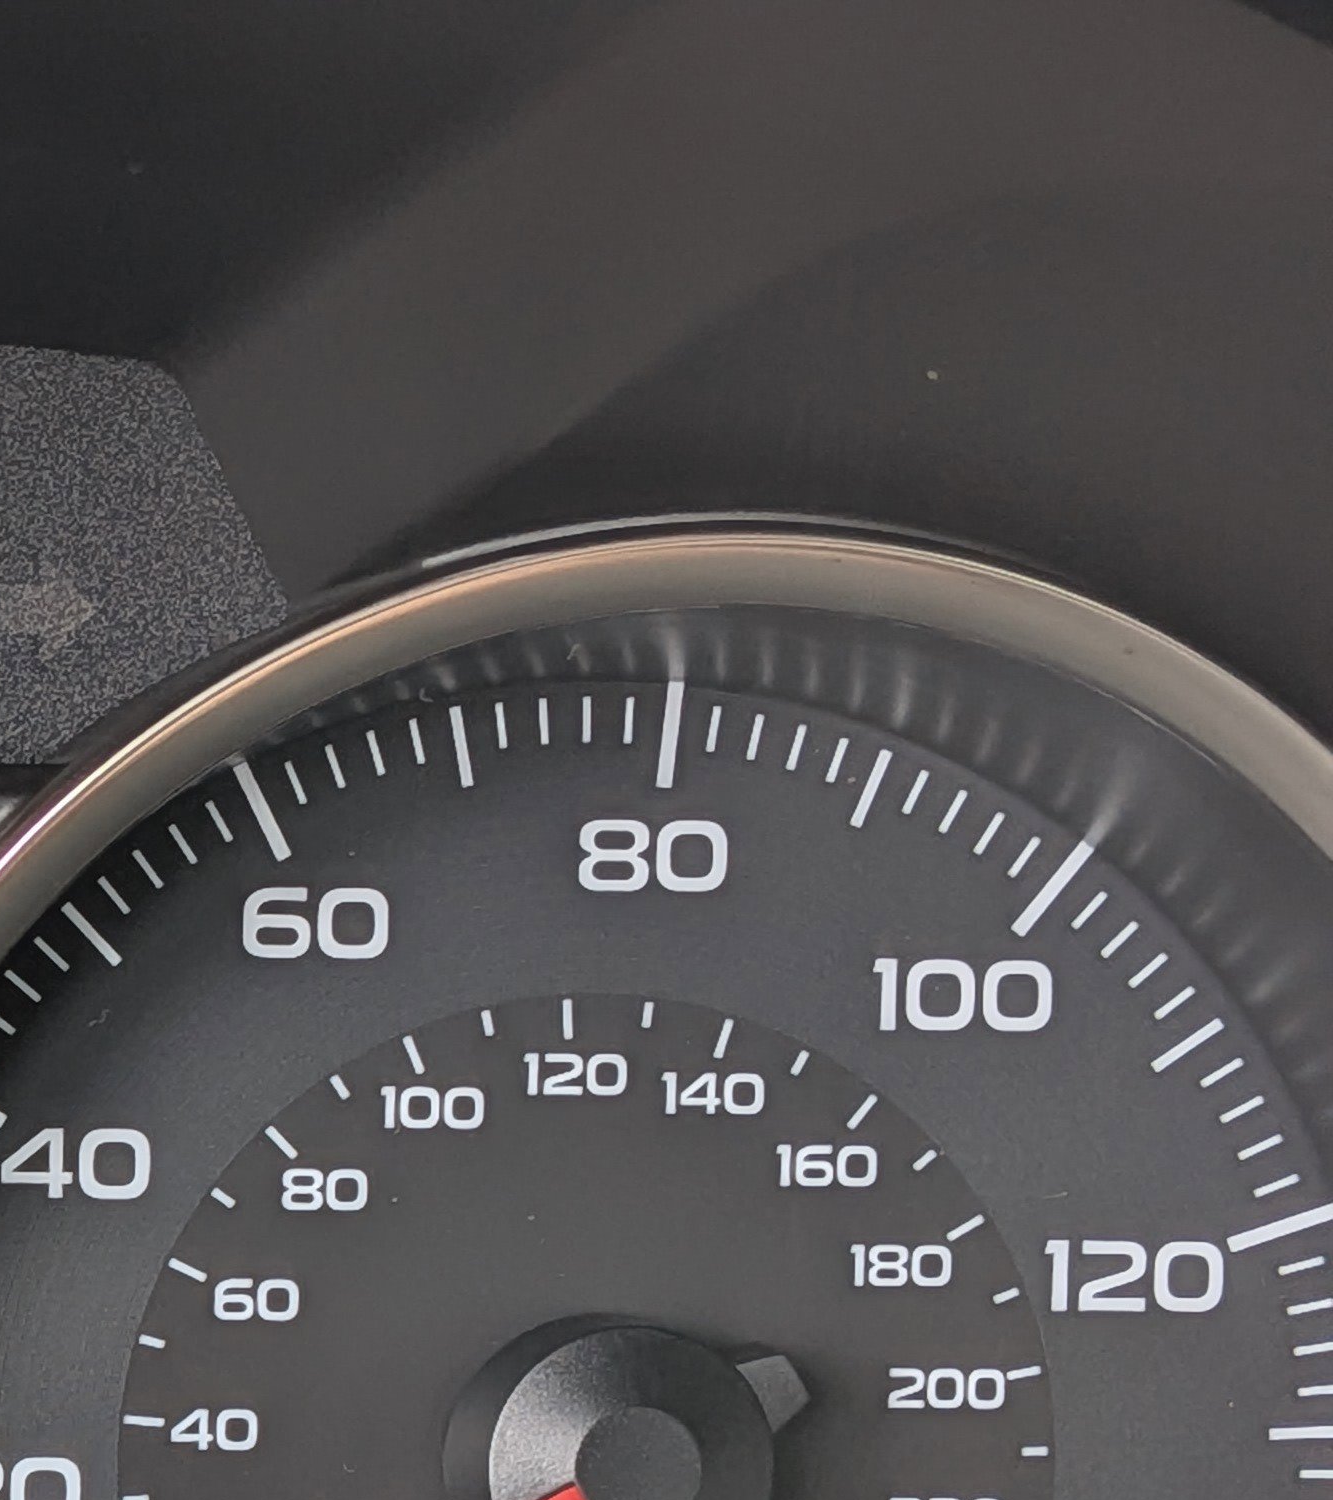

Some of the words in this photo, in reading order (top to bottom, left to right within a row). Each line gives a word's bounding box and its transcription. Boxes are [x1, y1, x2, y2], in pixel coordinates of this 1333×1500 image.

[579, 820, 727, 891] 80
[243, 888, 388, 959] 60
[873, 958, 1052, 1031] 100
[524, 1053, 627, 1095] 120
[662, 1072, 764, 1114] 140
[381, 1086, 484, 1129] 100
[0, 1128, 150, 1199] 40
[777, 1145, 877, 1186] 160
[282, 1169, 367, 1210] 80
[850, 1243, 952, 1287] 180
[1045, 1240, 1223, 1312] 120
[214, 1279, 299, 1321] 60
[888, 1368, 1005, 1409] 200
[171, 1409, 257, 1450] 40
